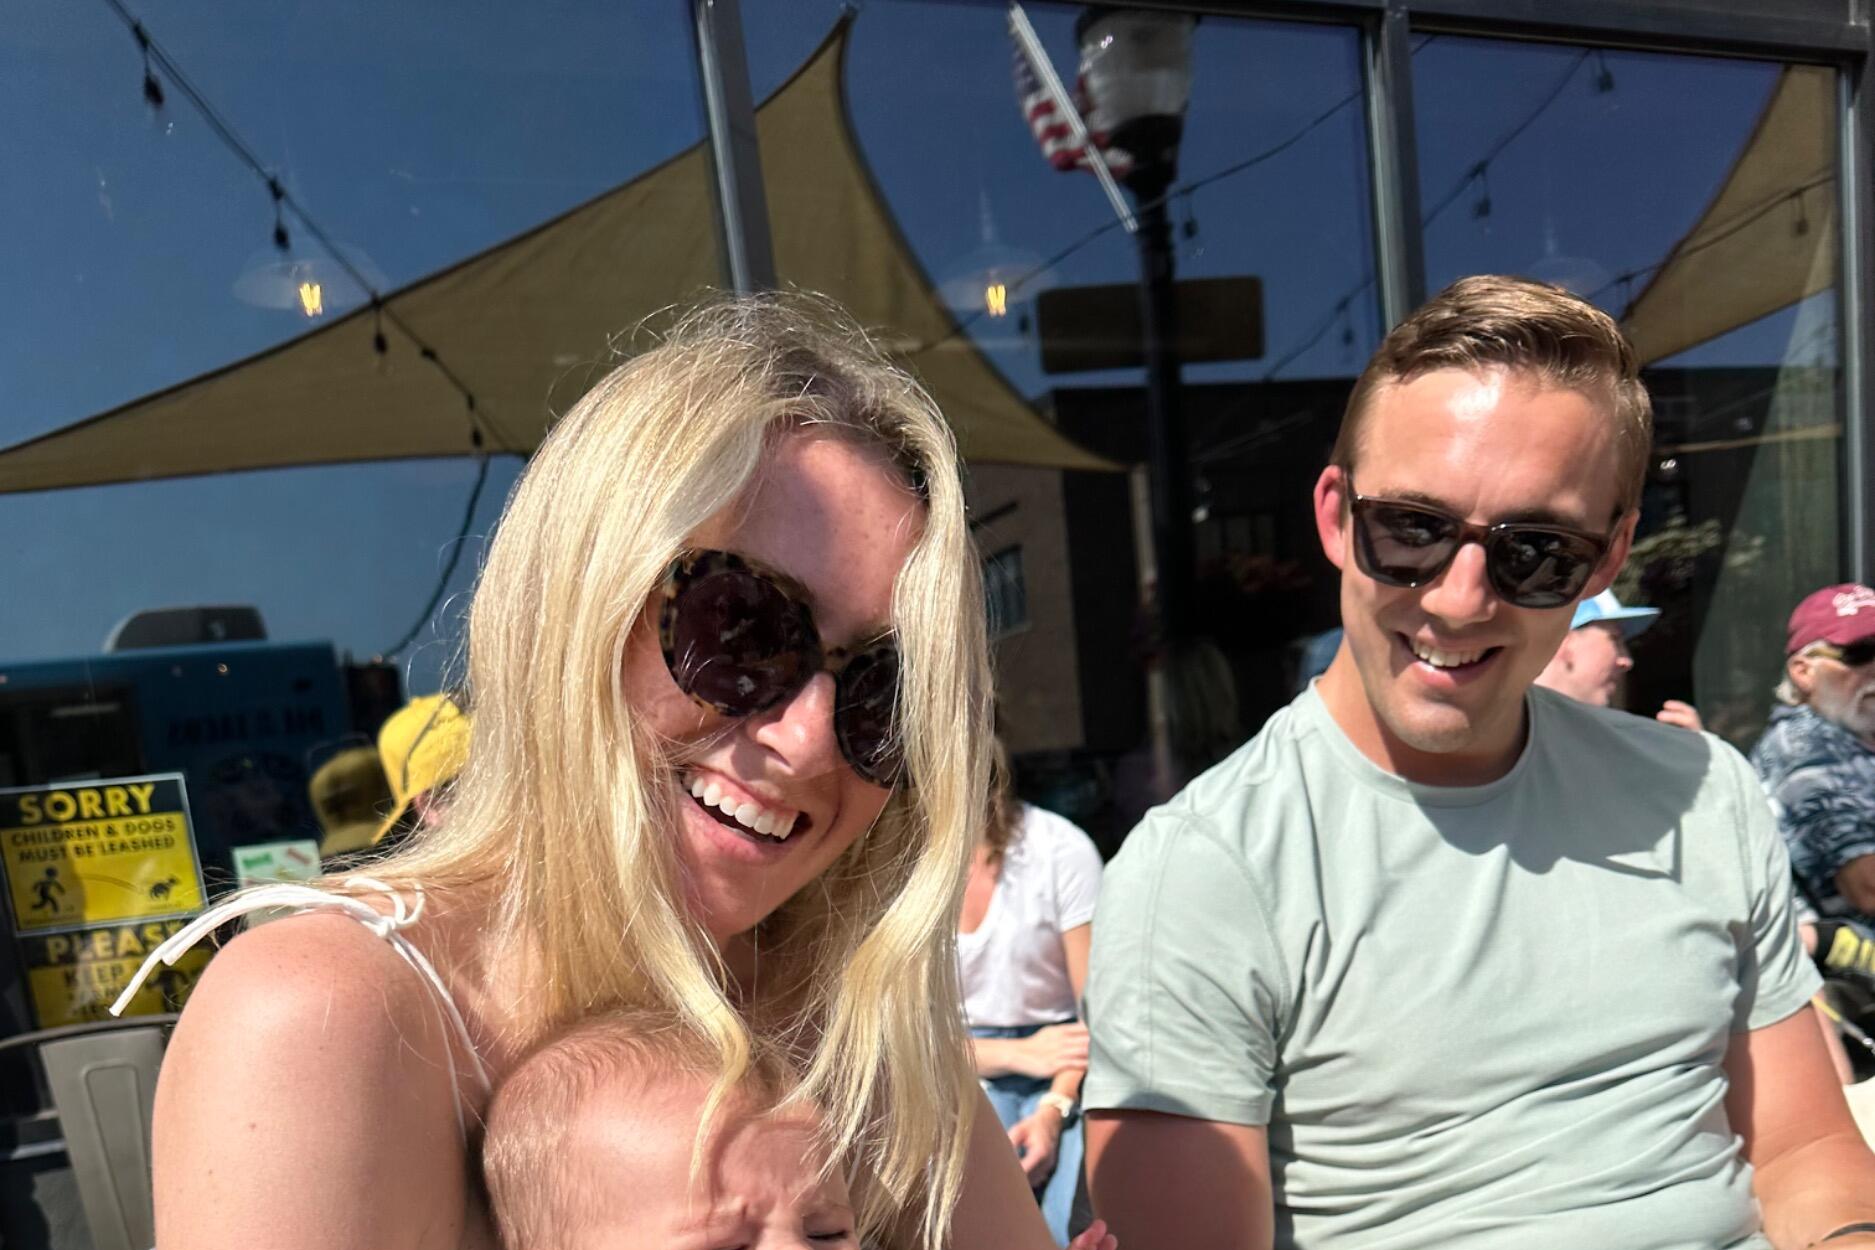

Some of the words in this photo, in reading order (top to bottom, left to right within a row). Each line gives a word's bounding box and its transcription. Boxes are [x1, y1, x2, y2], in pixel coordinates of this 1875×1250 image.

[19, 783, 155, 825] SORRY
[11, 824, 98, 847] CHILDREN
[106, 823, 119, 838] &
[125, 816, 176, 835] DOGS
[18, 841, 68, 863] MUST
[74, 843, 95, 858] BE
[102, 834, 175, 856] LEASHED
